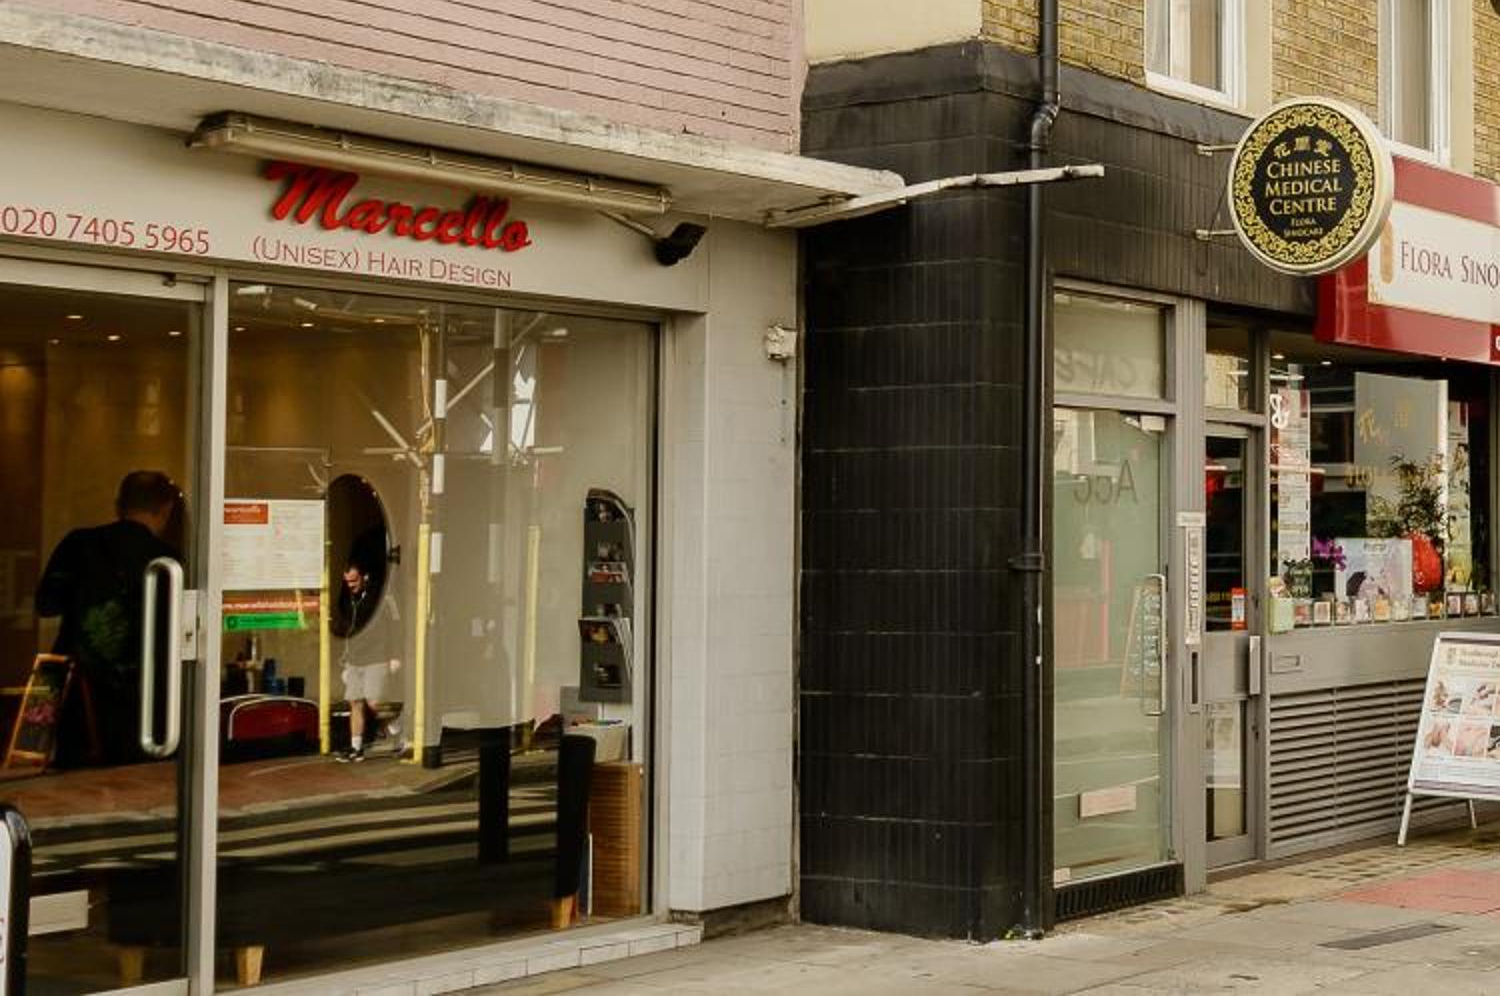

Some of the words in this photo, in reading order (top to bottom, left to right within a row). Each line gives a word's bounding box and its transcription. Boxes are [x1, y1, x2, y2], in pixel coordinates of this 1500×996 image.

[1265, 178, 1342, 197] MEDICAL
[1267, 159, 1341, 178] CHINESE
[258, 158, 533, 252] Marcello
[1269, 197, 1337, 215] CENTRE
[1, 207, 57, 236] 020
[66, 214, 135, 246] 7405
[145, 224, 210, 254] 5965
[252, 235, 360, 269] (UNISEX)
[368, 251, 423, 277] HAIR
[430, 258, 512, 287] DESIGN
[1400, 241, 1453, 279] FLORA
